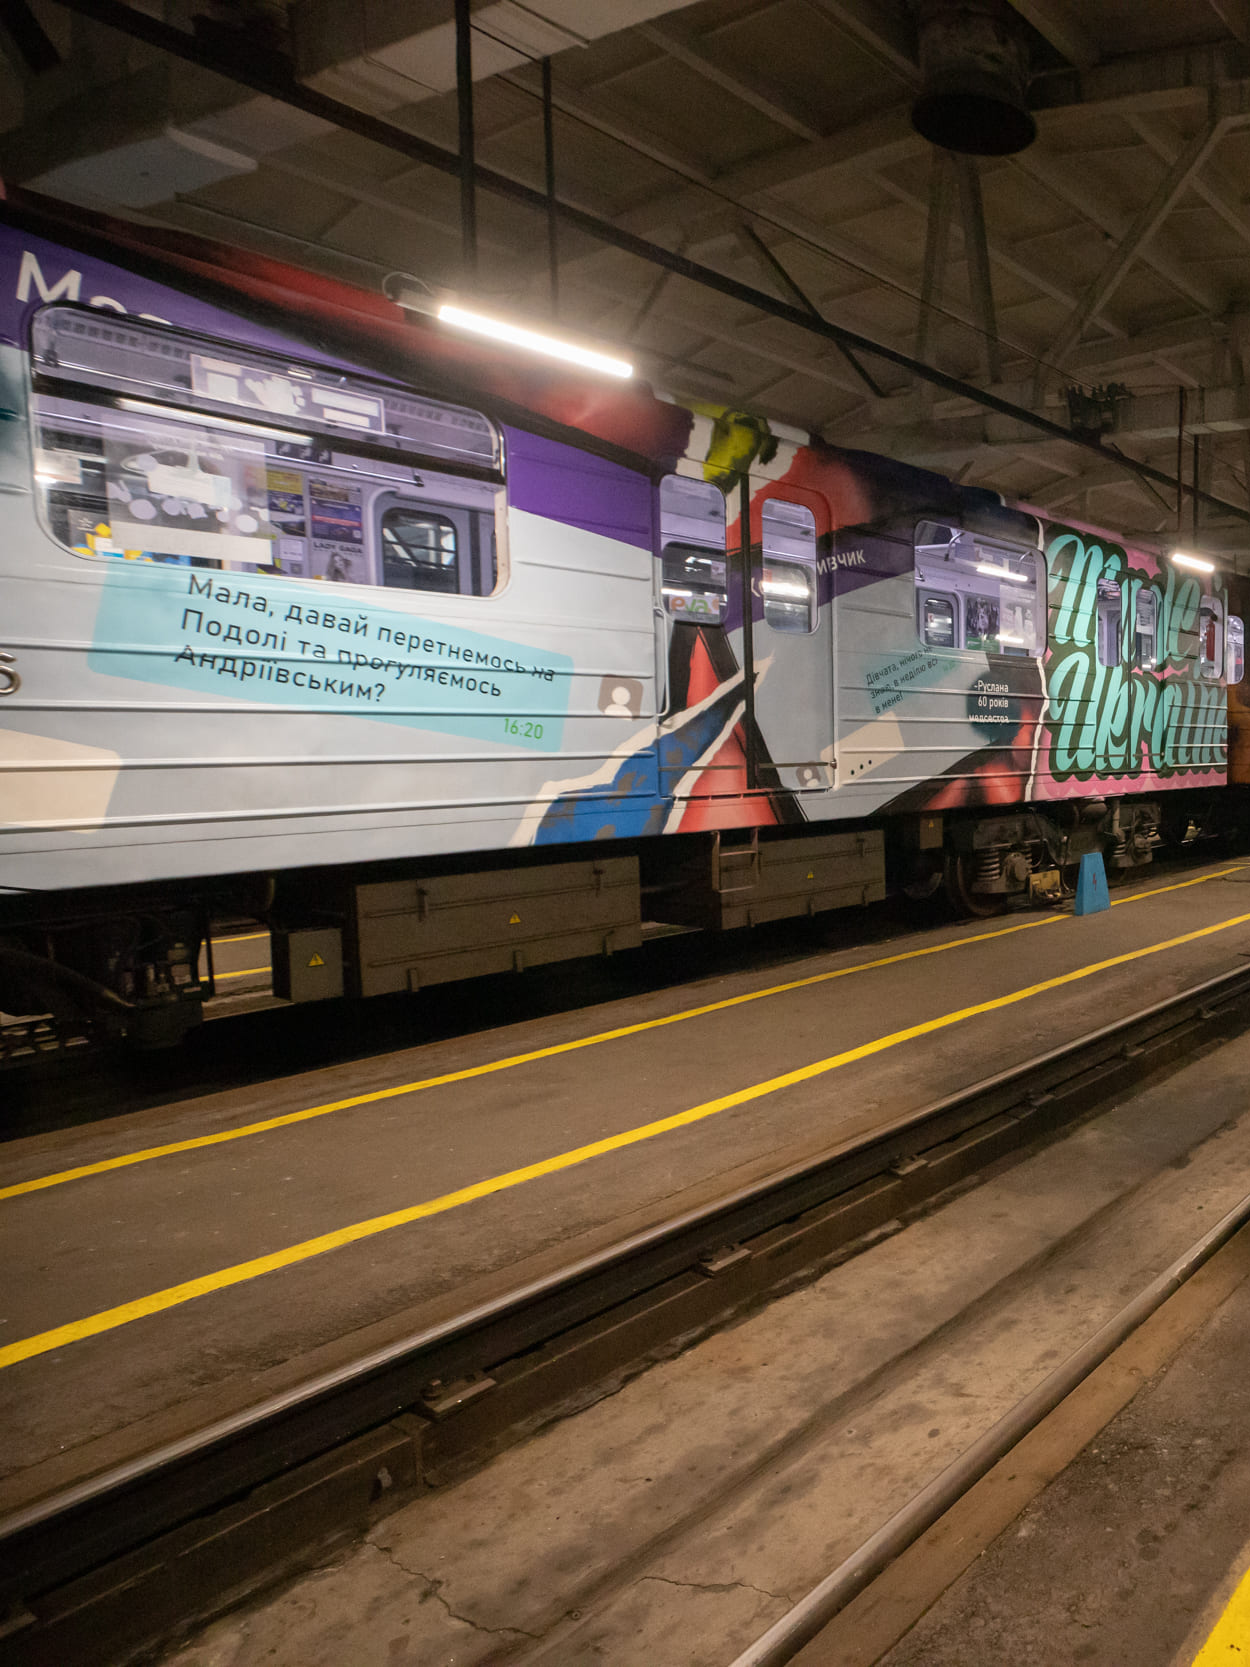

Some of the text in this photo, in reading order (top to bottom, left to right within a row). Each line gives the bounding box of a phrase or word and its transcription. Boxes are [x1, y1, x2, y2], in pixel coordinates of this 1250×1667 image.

[181, 608, 502, 697] Подолі та прогуляємось
[187, 573, 556, 682] Мала, давай перетнемось на
[174, 645, 385, 702] Андріївським?
[978, 695, 1009, 710] 60 років
[504, 718, 544, 740] 16:20
[1049, 652, 1227, 771] Ukraine
